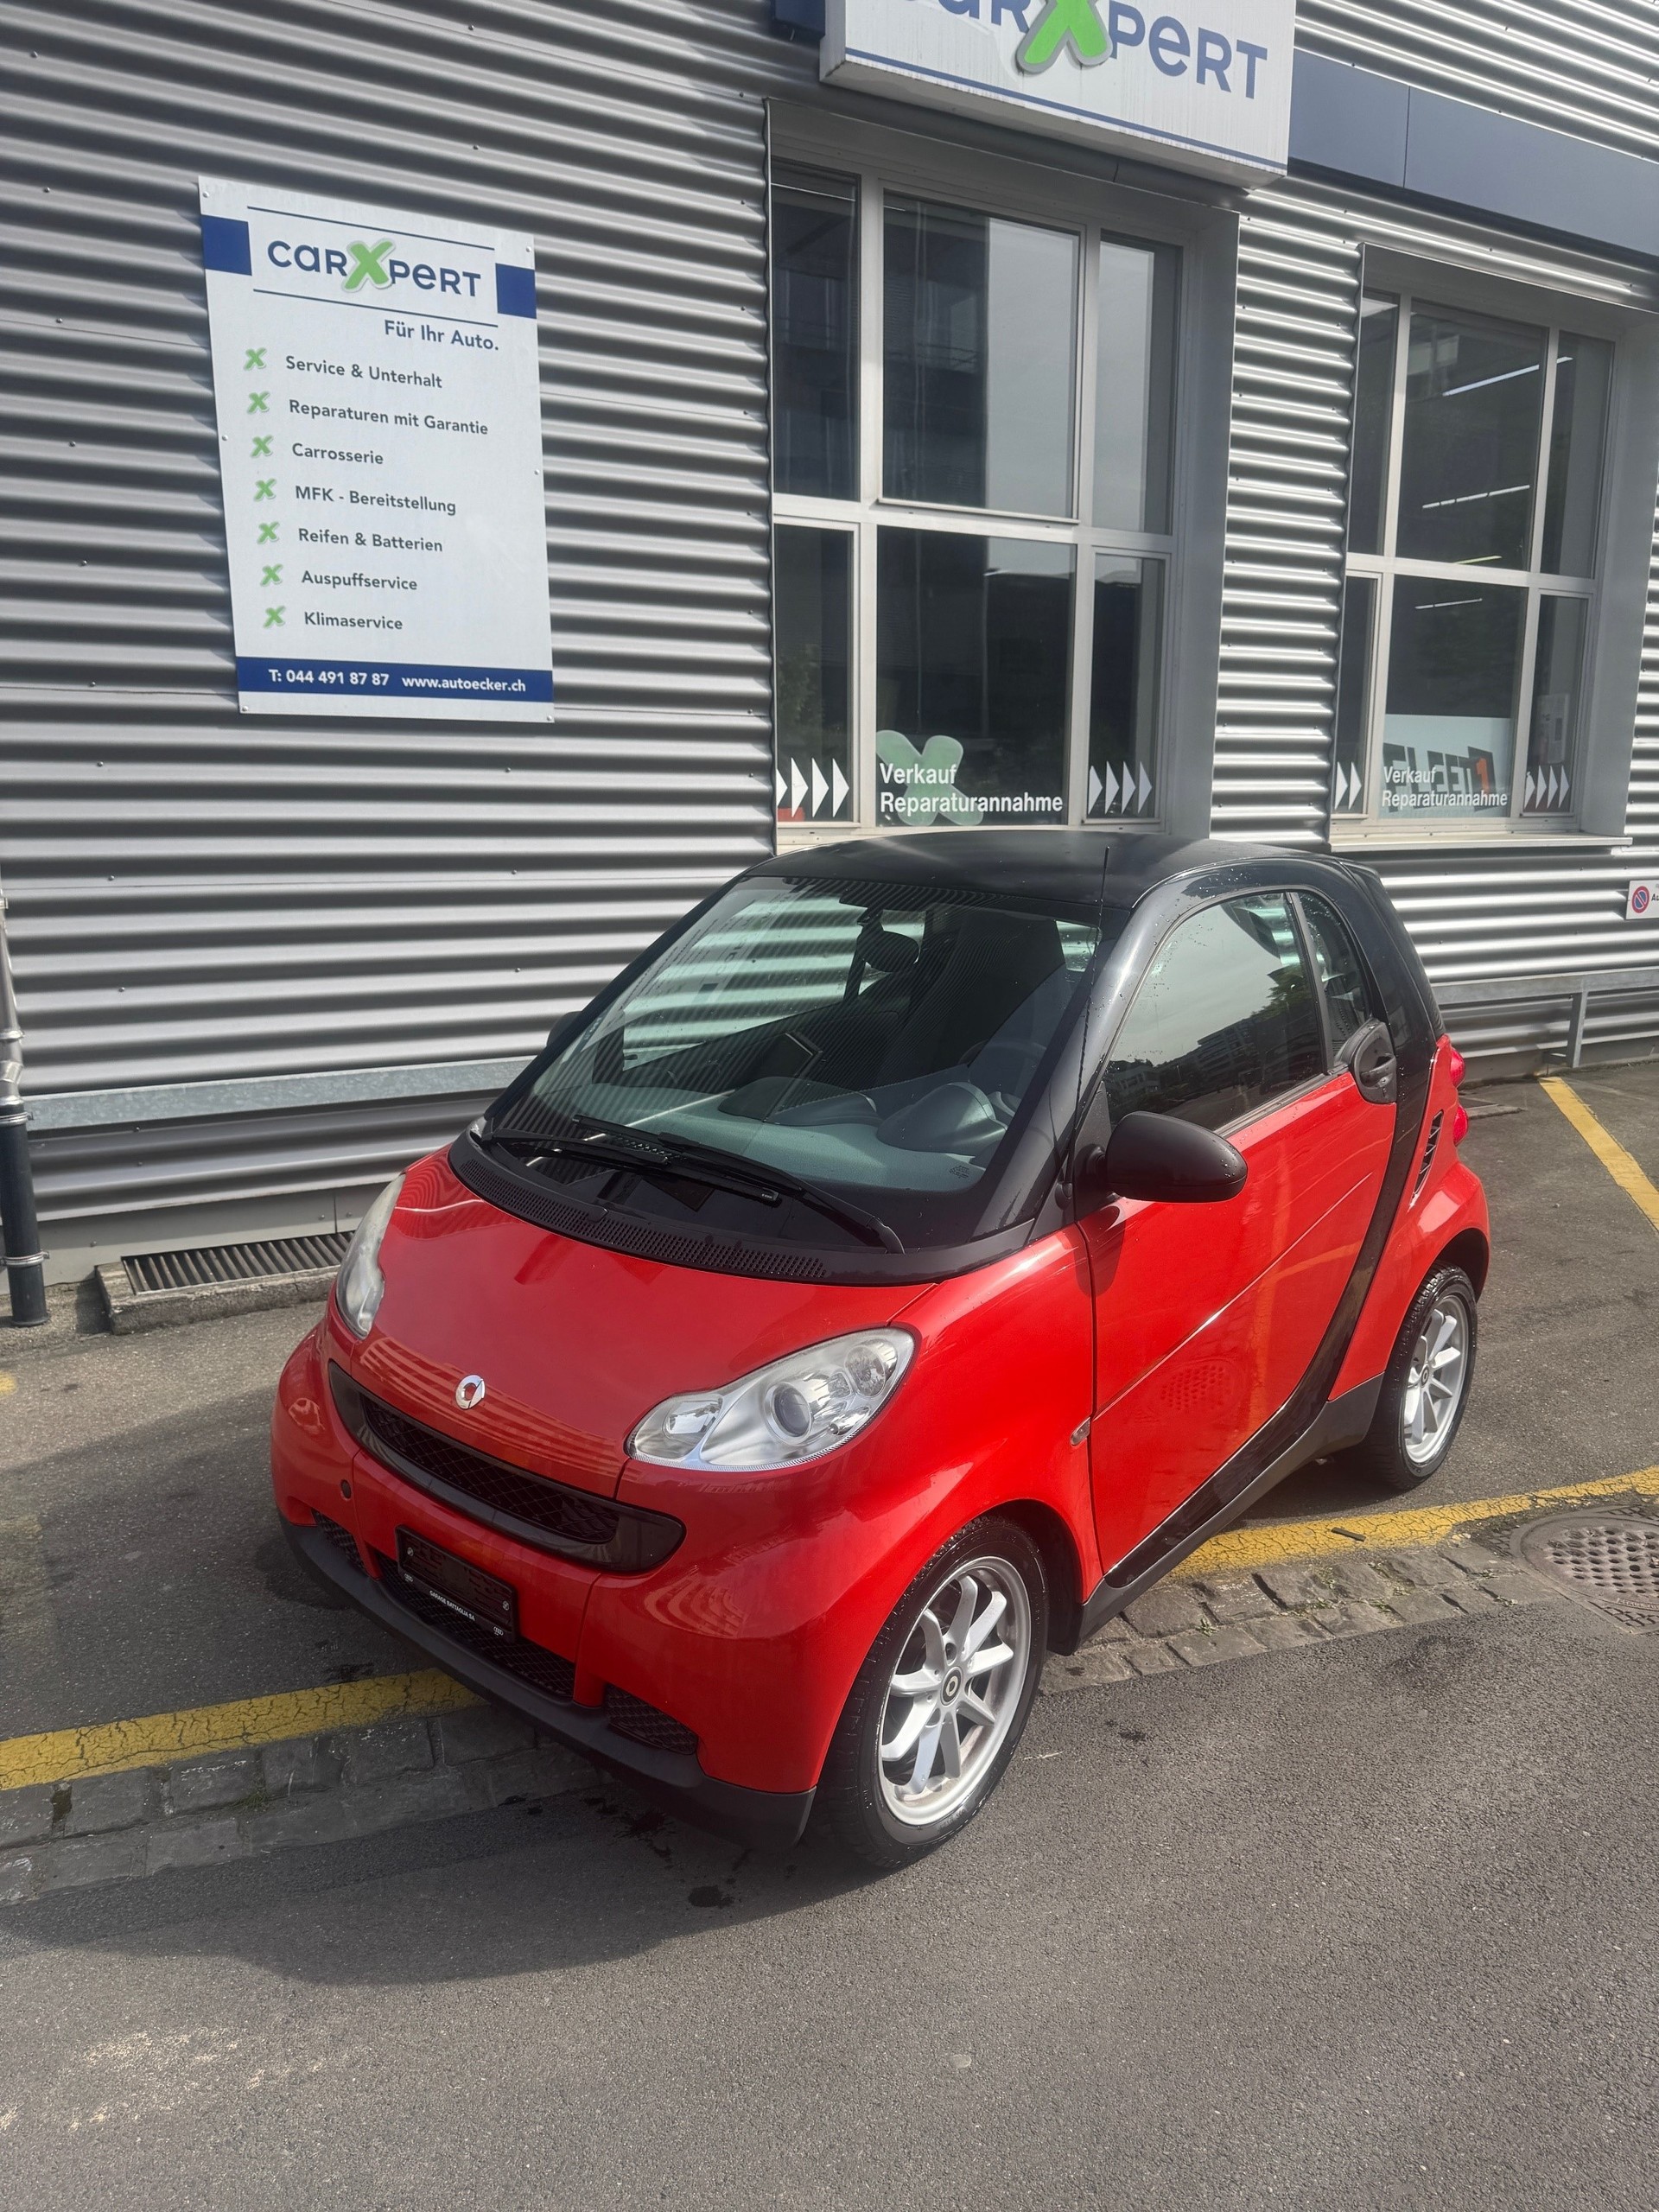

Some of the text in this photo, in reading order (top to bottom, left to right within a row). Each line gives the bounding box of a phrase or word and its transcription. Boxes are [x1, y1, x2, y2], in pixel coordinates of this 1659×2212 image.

[385, 320, 499, 351] Für Ihr Auto.
[286, 355, 442, 388] Service & Unterhalt
[289, 399, 488, 435] Reparaturen mit Garantie
[292, 442, 384, 465] Carrosserie
[295, 485, 334, 503] MFK
[349, 491, 456, 516] Bereitstellung
[298, 528, 443, 552] Reifen & Batterien
[302, 570, 417, 591] Auspuffservice
[304, 612, 404, 630] Klimaservice
[268, 669, 525, 691] T: 044 491 87 87 www.autoecker.ch
[880, 762, 957, 785] Verkauf
[1383, 766, 1437, 784] Verkauf
[880, 791, 1063, 816] Reparaturannahme
[1382, 790, 1508, 809] Reparaturannahme
